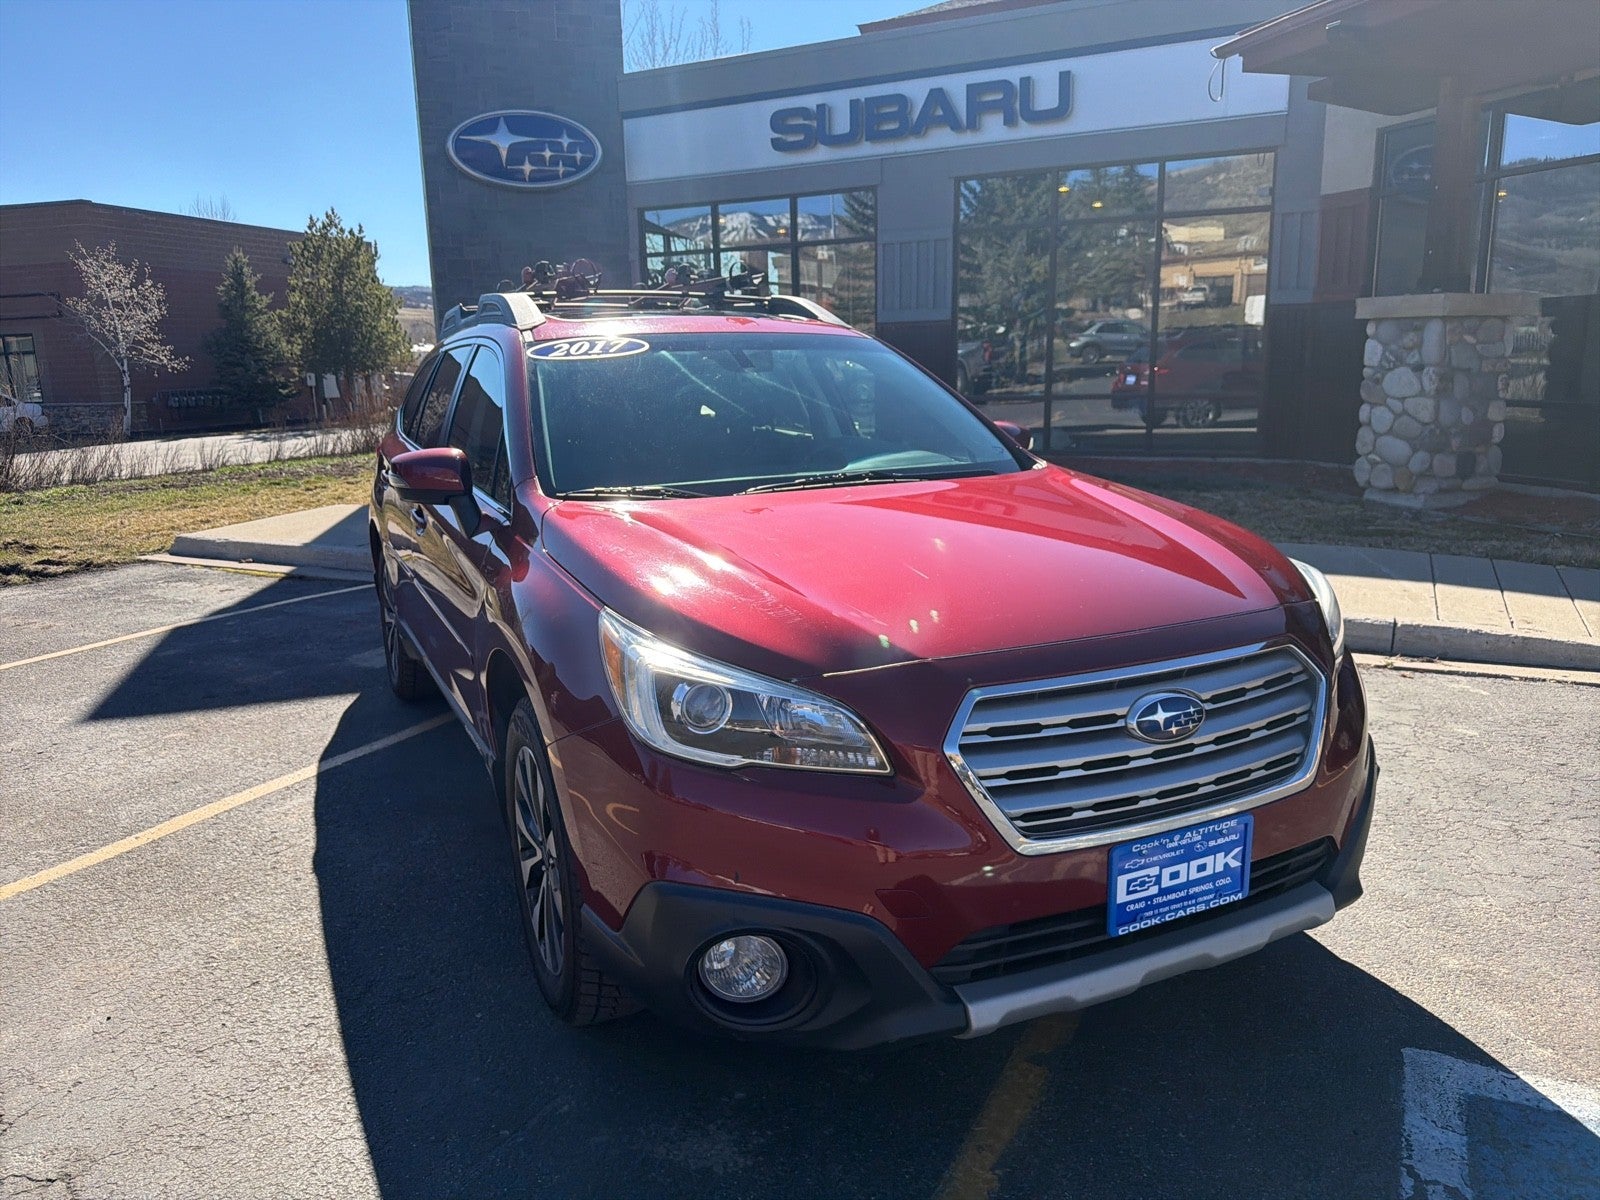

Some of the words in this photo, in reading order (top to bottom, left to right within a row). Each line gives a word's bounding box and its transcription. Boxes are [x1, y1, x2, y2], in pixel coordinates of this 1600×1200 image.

[769, 70, 1074, 153] SUBARU
[548, 339, 630, 358] 2017
[1132, 838, 1170, 852] Cook'n
[1183, 819, 1239, 840] ALTITUDE
[1207, 833, 1240, 848] SUBARU
[1146, 849, 1184, 863] CHEVROLET
[1126, 900, 1146, 912] CRAIG
[1152, 889, 1188, 905] STEAMBOAT
[1118, 892, 1243, 935] COOK-CARS.COM
